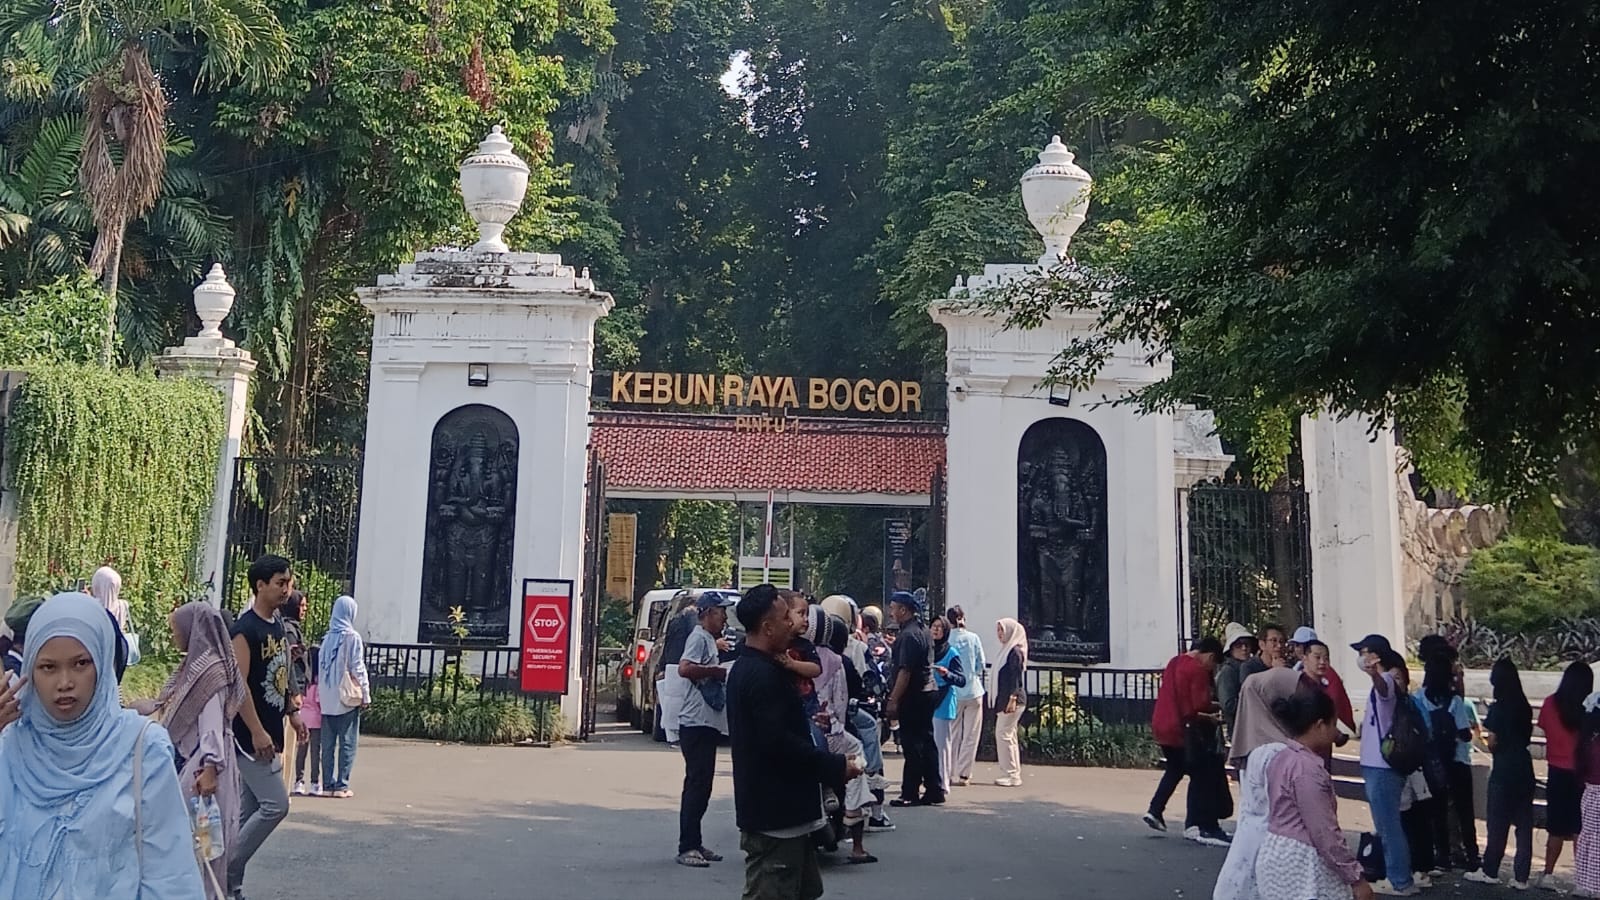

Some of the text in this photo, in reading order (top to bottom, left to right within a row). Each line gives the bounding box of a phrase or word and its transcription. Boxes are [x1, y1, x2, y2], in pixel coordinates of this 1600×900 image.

[612, 371, 921, 412] KEBUN RAYA BOGOR
[736, 416, 799, 436] PINTU 1
[534, 619, 558, 627] STOP
